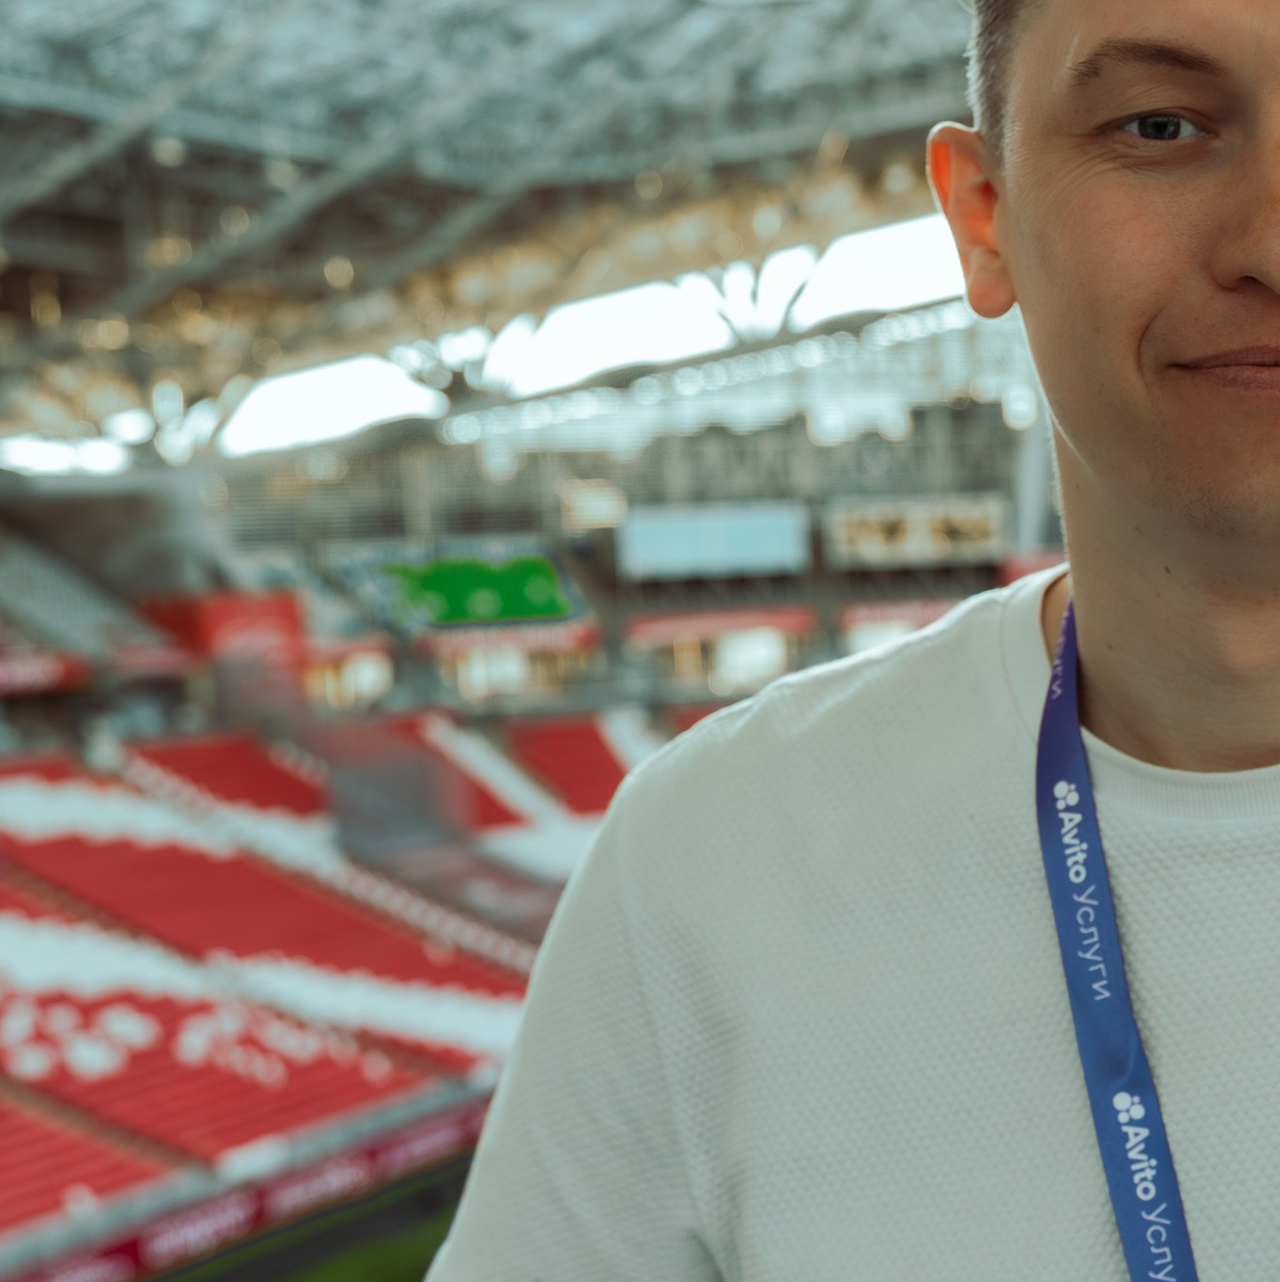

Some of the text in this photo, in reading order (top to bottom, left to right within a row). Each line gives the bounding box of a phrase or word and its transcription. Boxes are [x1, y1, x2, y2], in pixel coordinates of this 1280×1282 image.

[1058, 811, 1111, 1001] Avito Услуги
[1121, 1125, 1156, 1201] Avito
